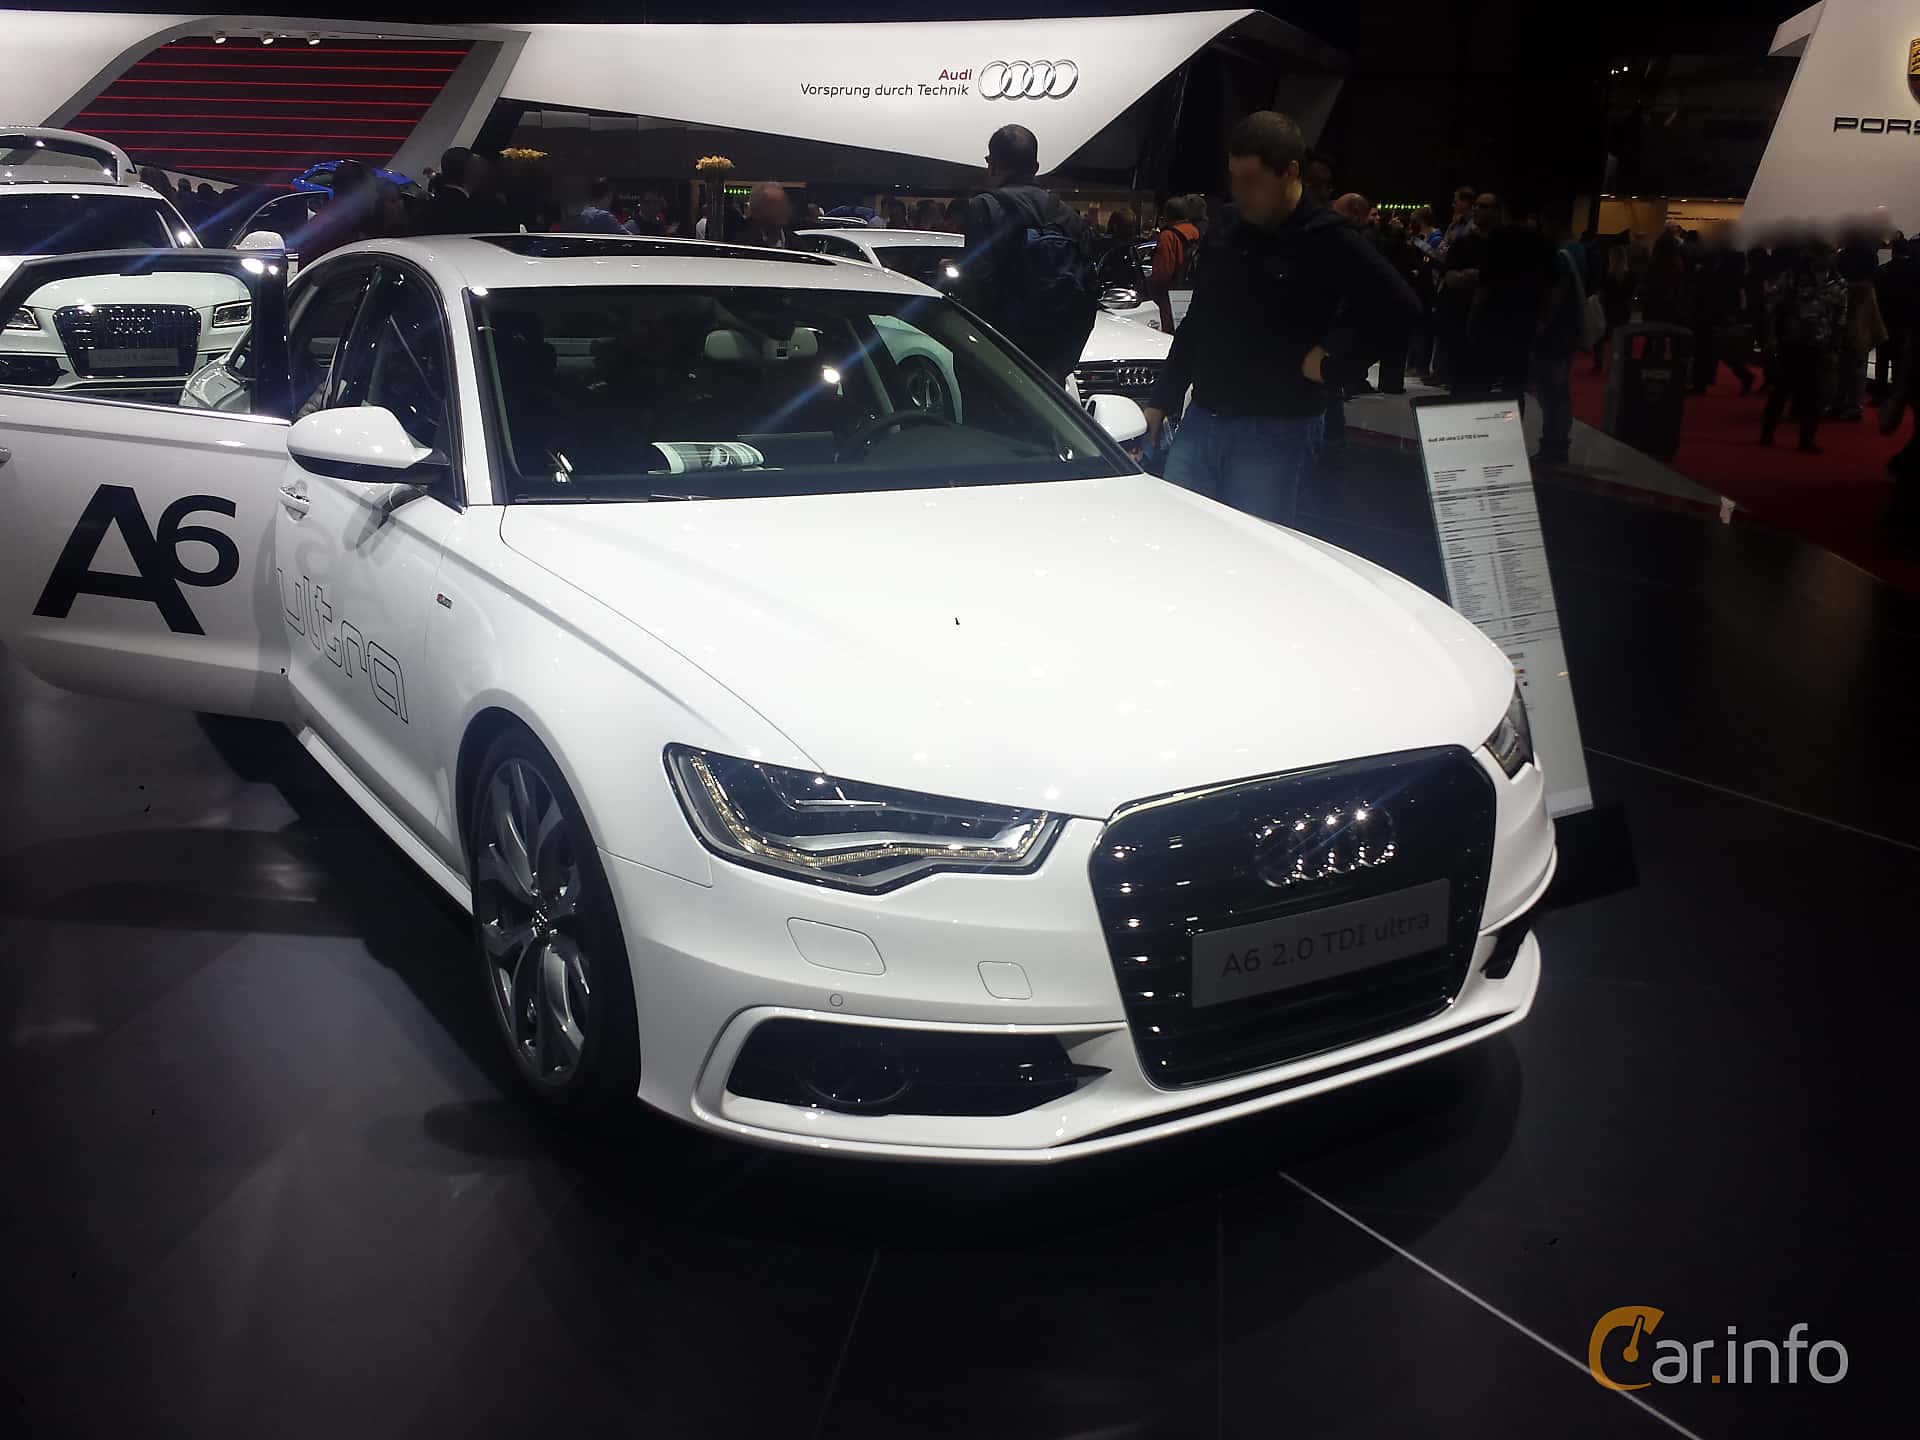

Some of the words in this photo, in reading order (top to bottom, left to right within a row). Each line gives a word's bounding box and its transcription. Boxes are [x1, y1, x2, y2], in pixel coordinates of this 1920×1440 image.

[800, 83, 871, 98] Vorsprung
[875, 84, 913, 96] durch
[917, 84, 970, 97] Technik
[938, 68, 973, 81] Audi
[1833, 116, 1920, 135] POR
[32, 484, 240, 636] A6
[276, 568, 409, 724] ultra
[1222, 947, 1262, 977] A6
[1271, 936, 1315, 967] 2.0
[1320, 924, 1369, 954] TDI
[1375, 912, 1431, 942] ultra
